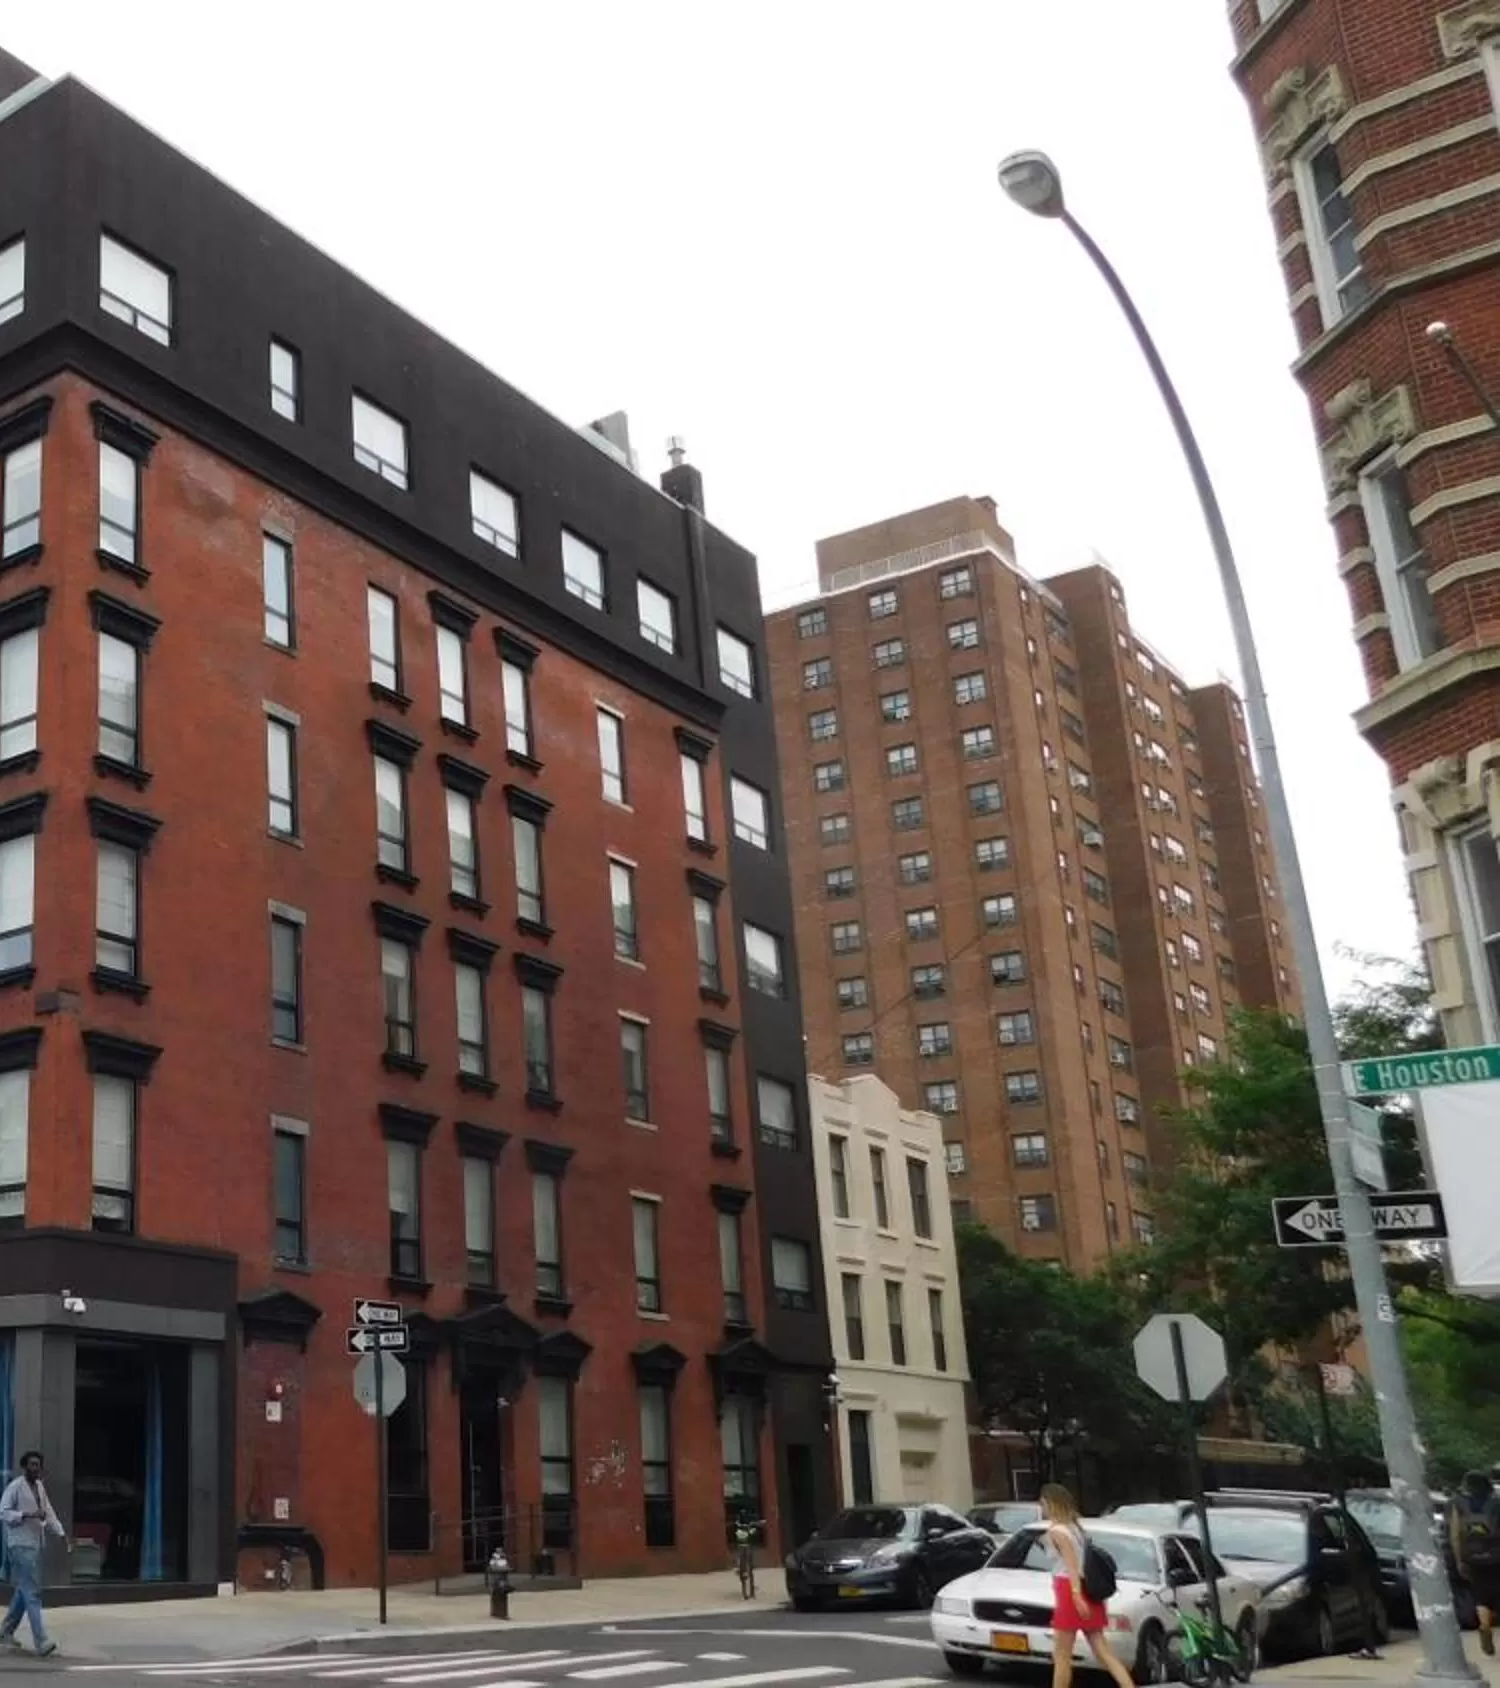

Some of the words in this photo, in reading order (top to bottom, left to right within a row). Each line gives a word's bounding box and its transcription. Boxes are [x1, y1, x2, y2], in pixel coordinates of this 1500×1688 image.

[1355, 1066, 1368, 1090] E
[1377, 1055, 1490, 1089] Houston
[1301, 1212, 1343, 1230] ONE
[1372, 1207, 1421, 1226] WAY
